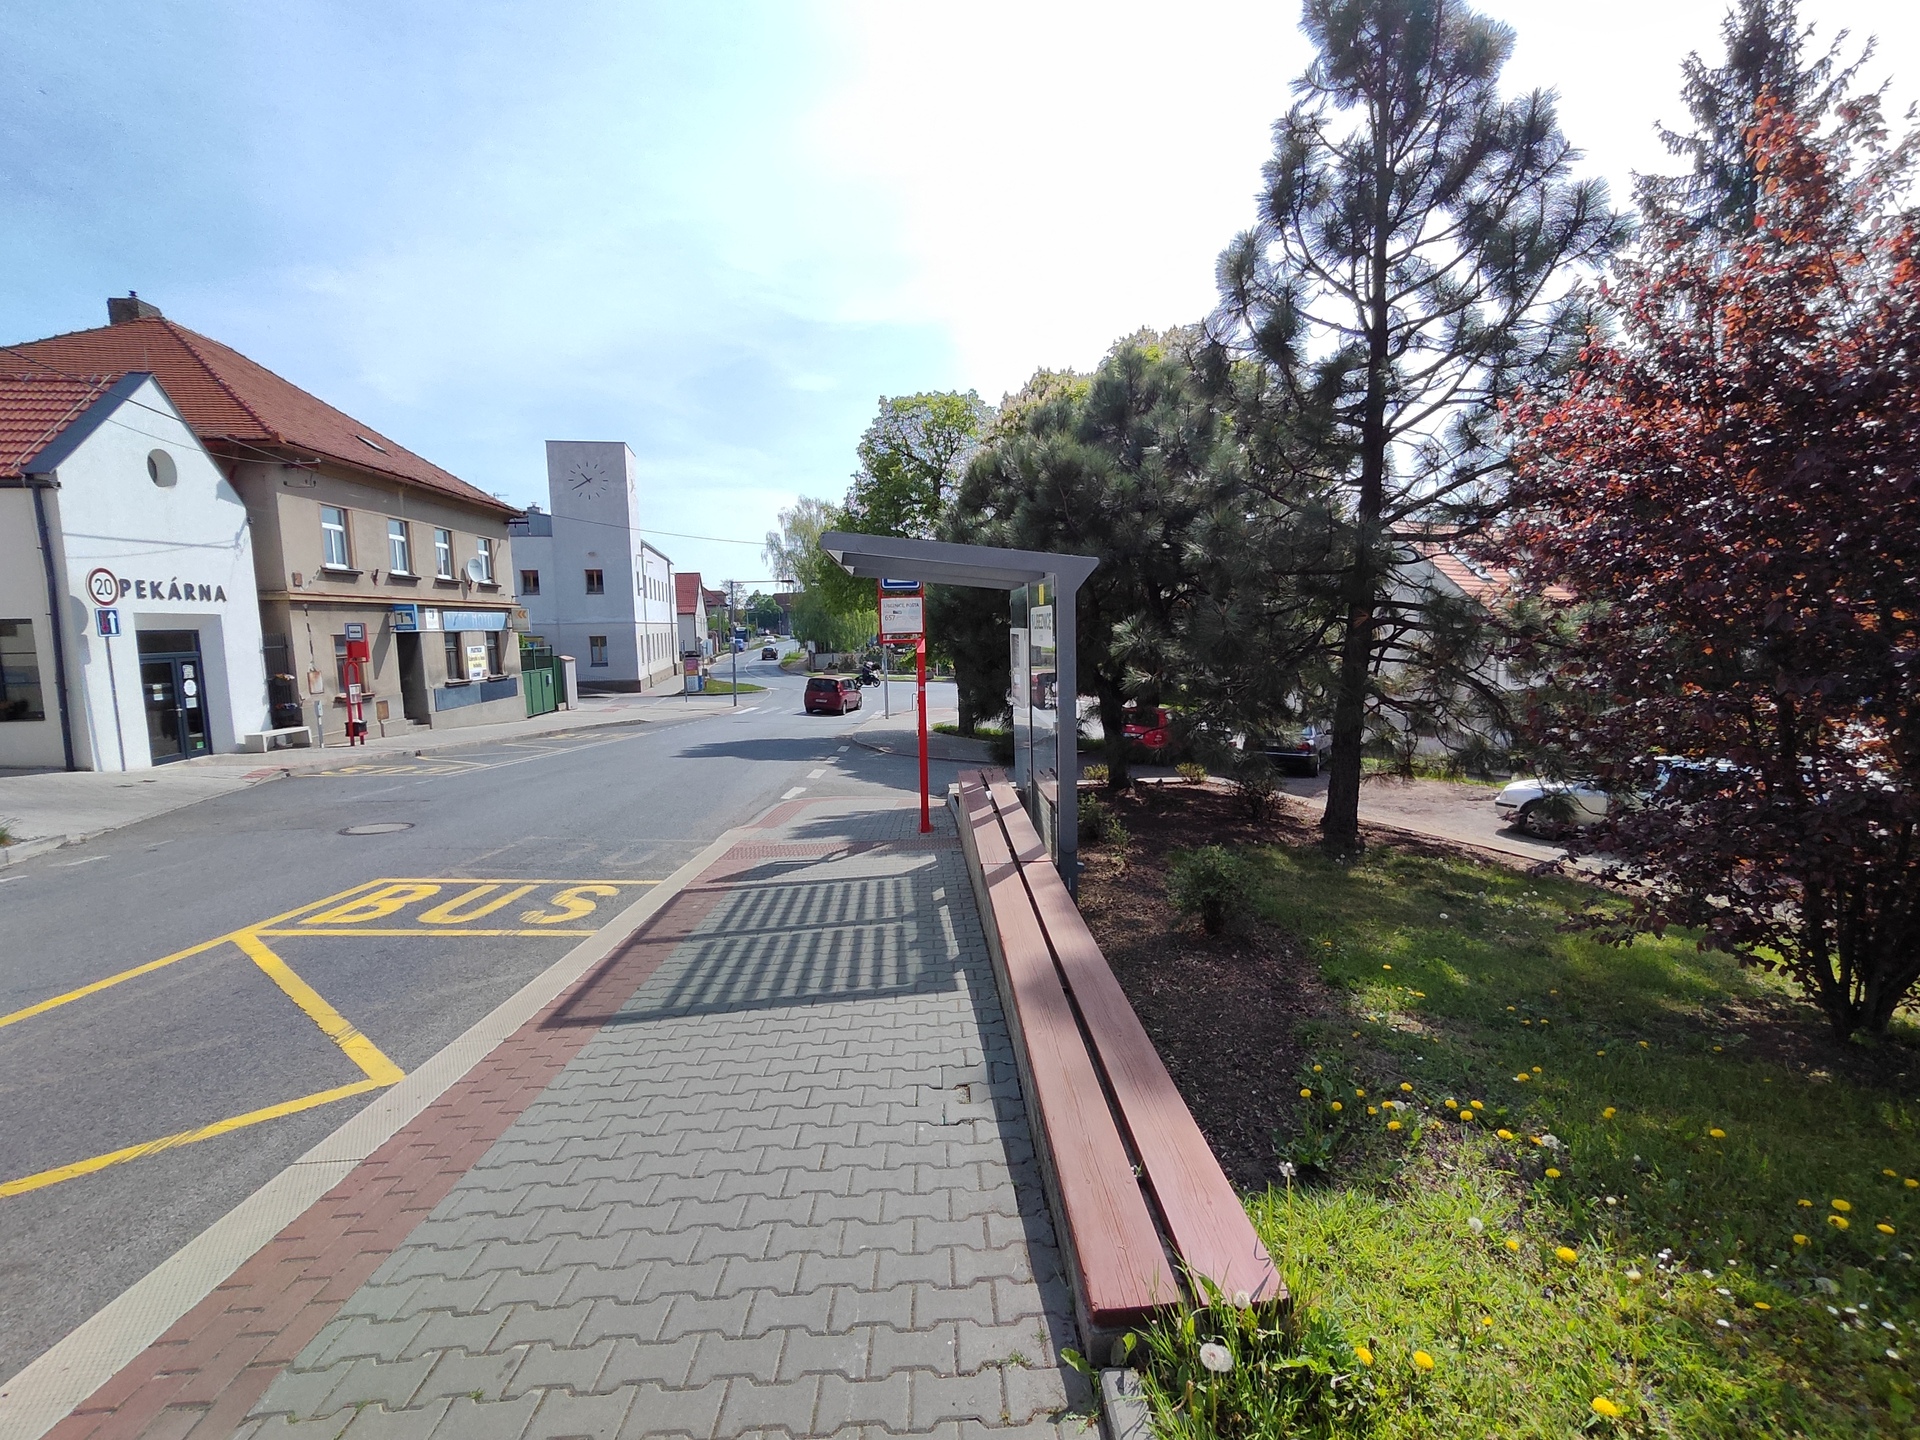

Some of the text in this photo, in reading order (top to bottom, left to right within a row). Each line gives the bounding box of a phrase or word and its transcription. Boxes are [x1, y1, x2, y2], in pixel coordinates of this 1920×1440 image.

[95, 578, 113, 596] 20
[118, 576, 227, 603] PEKÁRNA
[472, 614, 493, 628] MOTO
[297, 884, 621, 925] BUS
